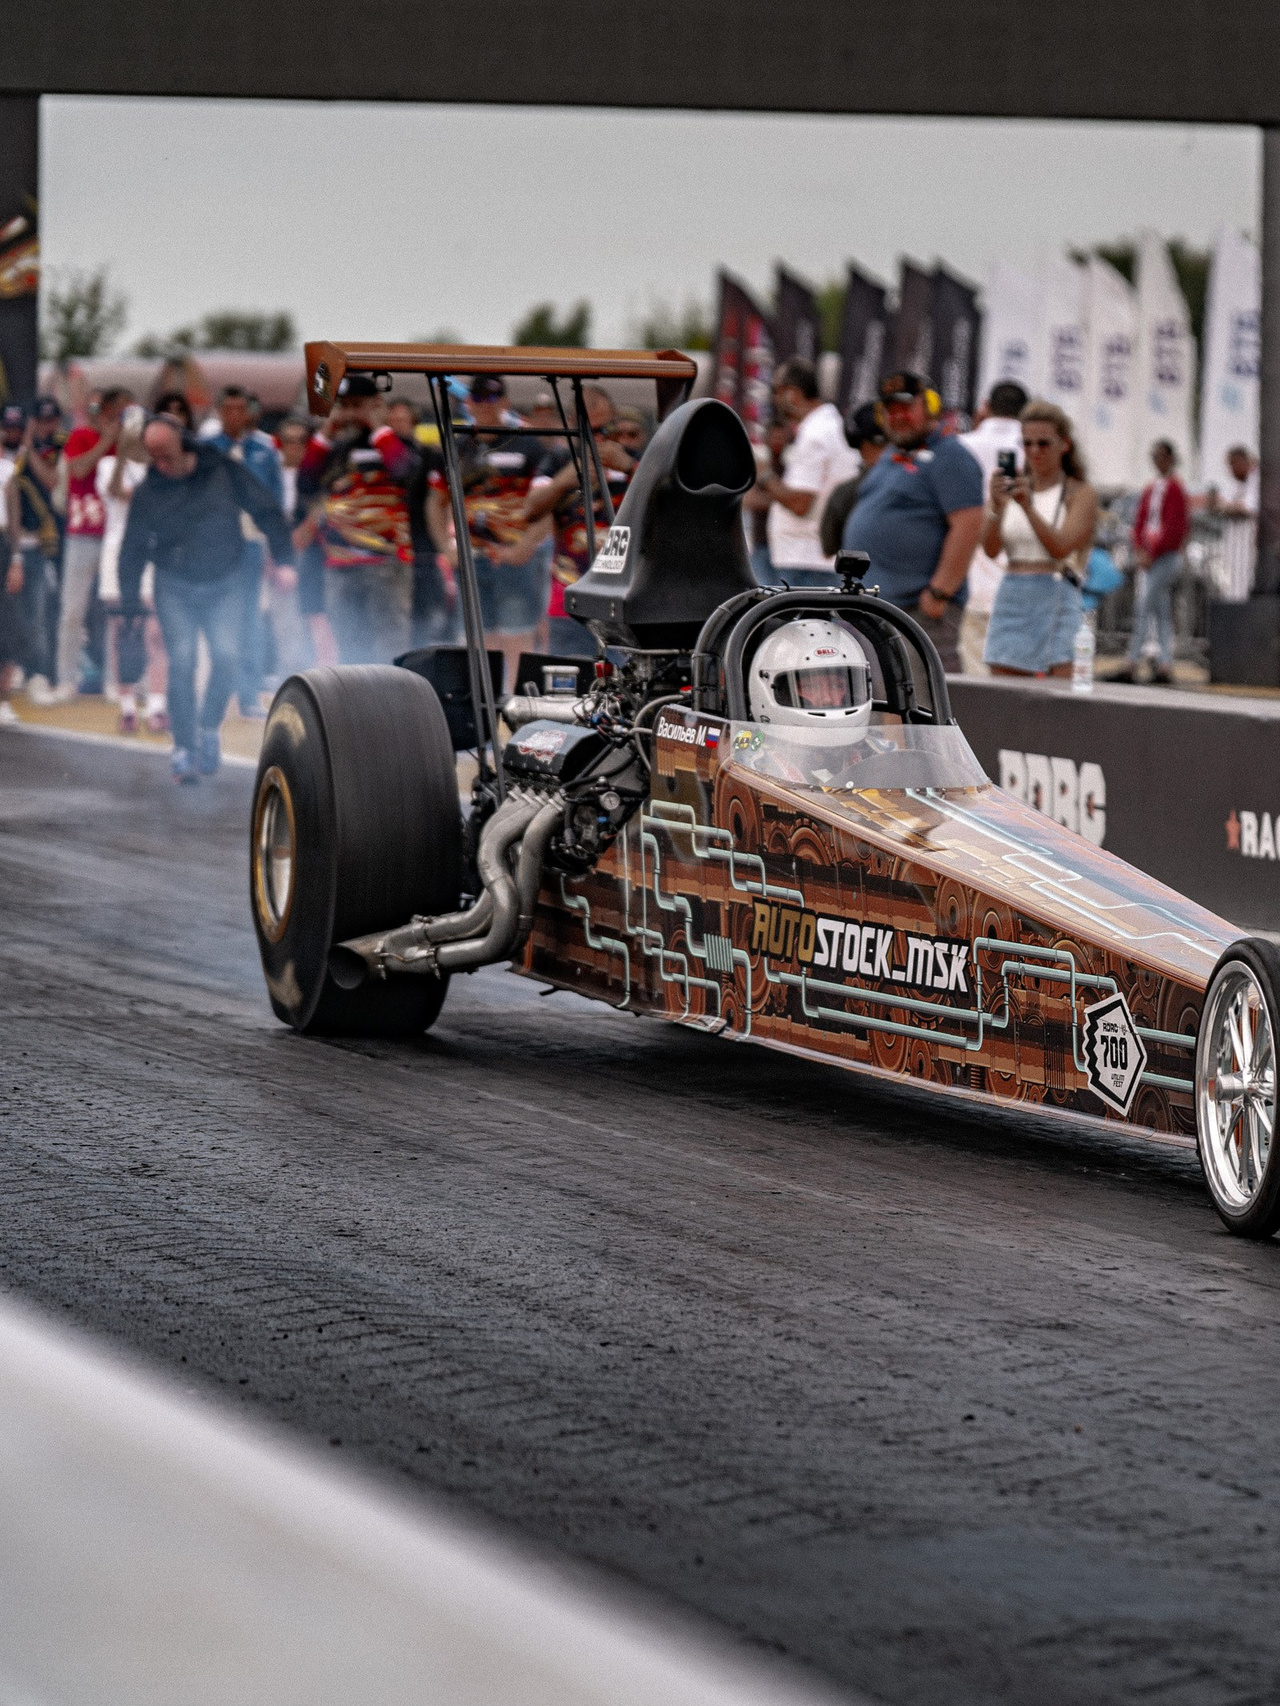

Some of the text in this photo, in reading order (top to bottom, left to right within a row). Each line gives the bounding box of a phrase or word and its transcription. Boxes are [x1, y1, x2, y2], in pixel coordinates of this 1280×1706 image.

[657, 716, 696, 744] Васильев
[999, 748, 1106, 847] RDRC
[1103, 1022, 1118, 1033] RDRC
[1101, 1034, 1128, 1070] 700
[1113, 1080, 1124, 1088] FEST
